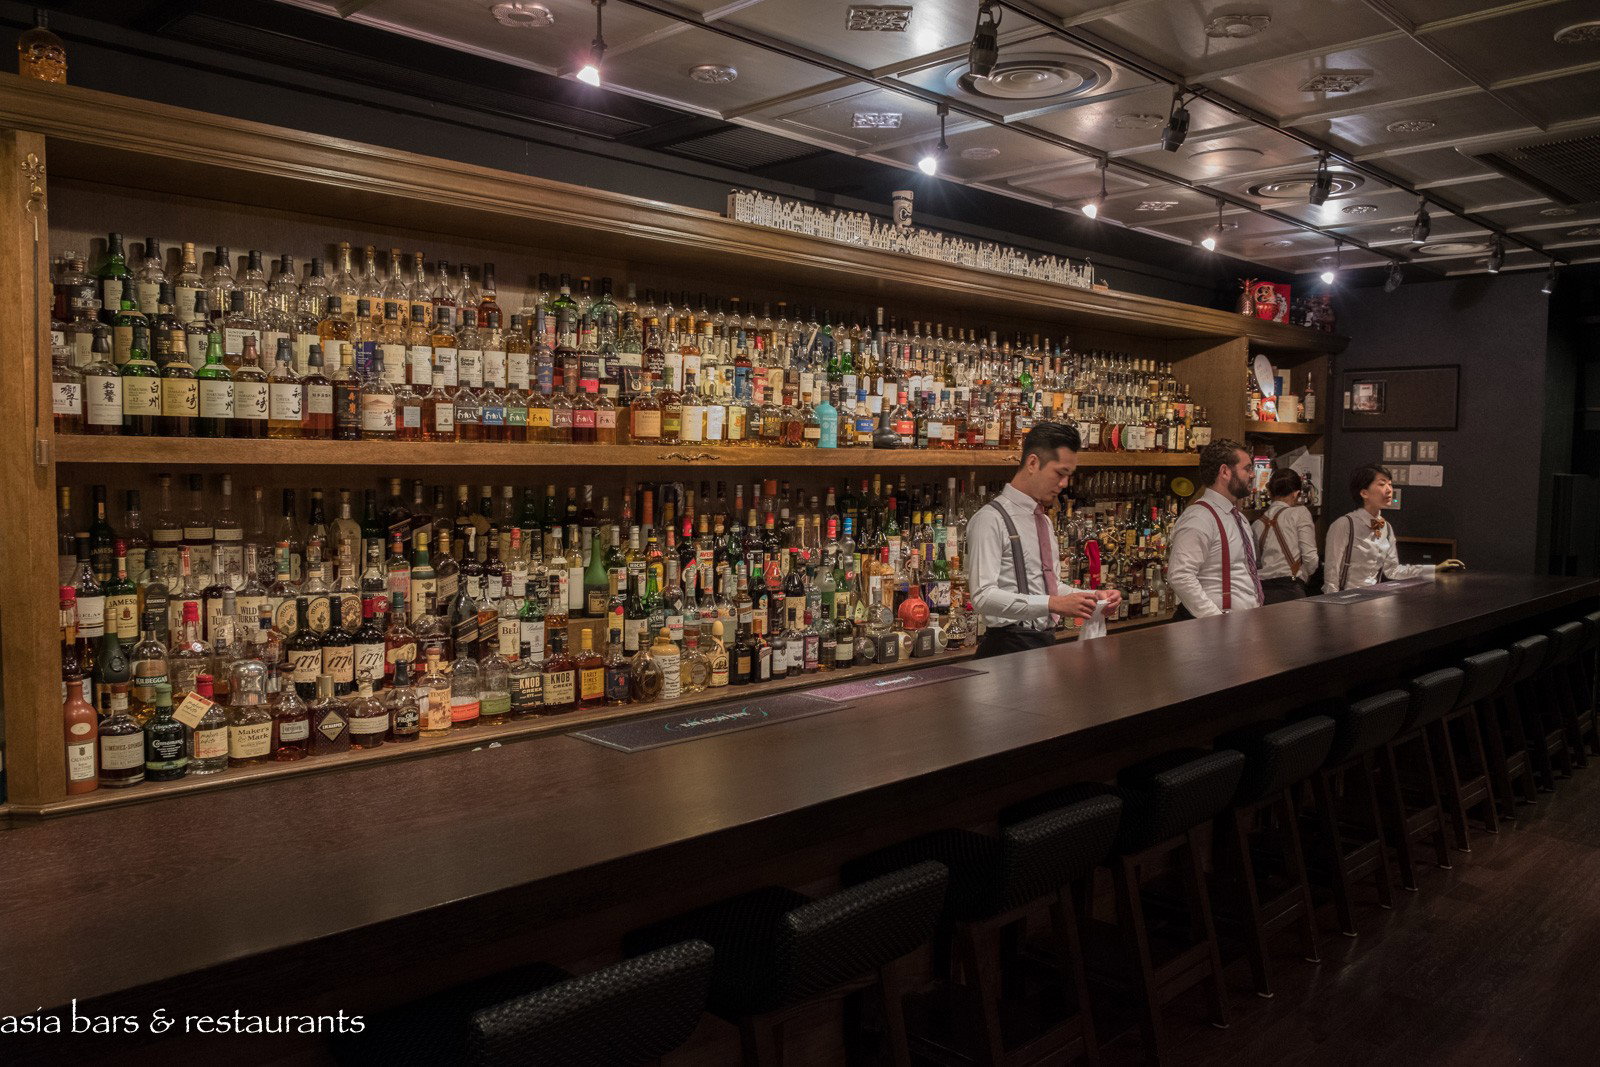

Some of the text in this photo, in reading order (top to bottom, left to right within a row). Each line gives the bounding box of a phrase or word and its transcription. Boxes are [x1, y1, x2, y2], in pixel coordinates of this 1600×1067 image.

[149, 381, 160, 410] 白州
[295, 655, 320, 669] 1776
[328, 655, 353, 670] 1776
[359, 651, 384, 666] 1776
[519, 676, 541, 690] KNOB
[550, 672, 571, 685] KNOB
[553, 682, 573, 690] CREEK
[247, 732, 269, 743] Mark
